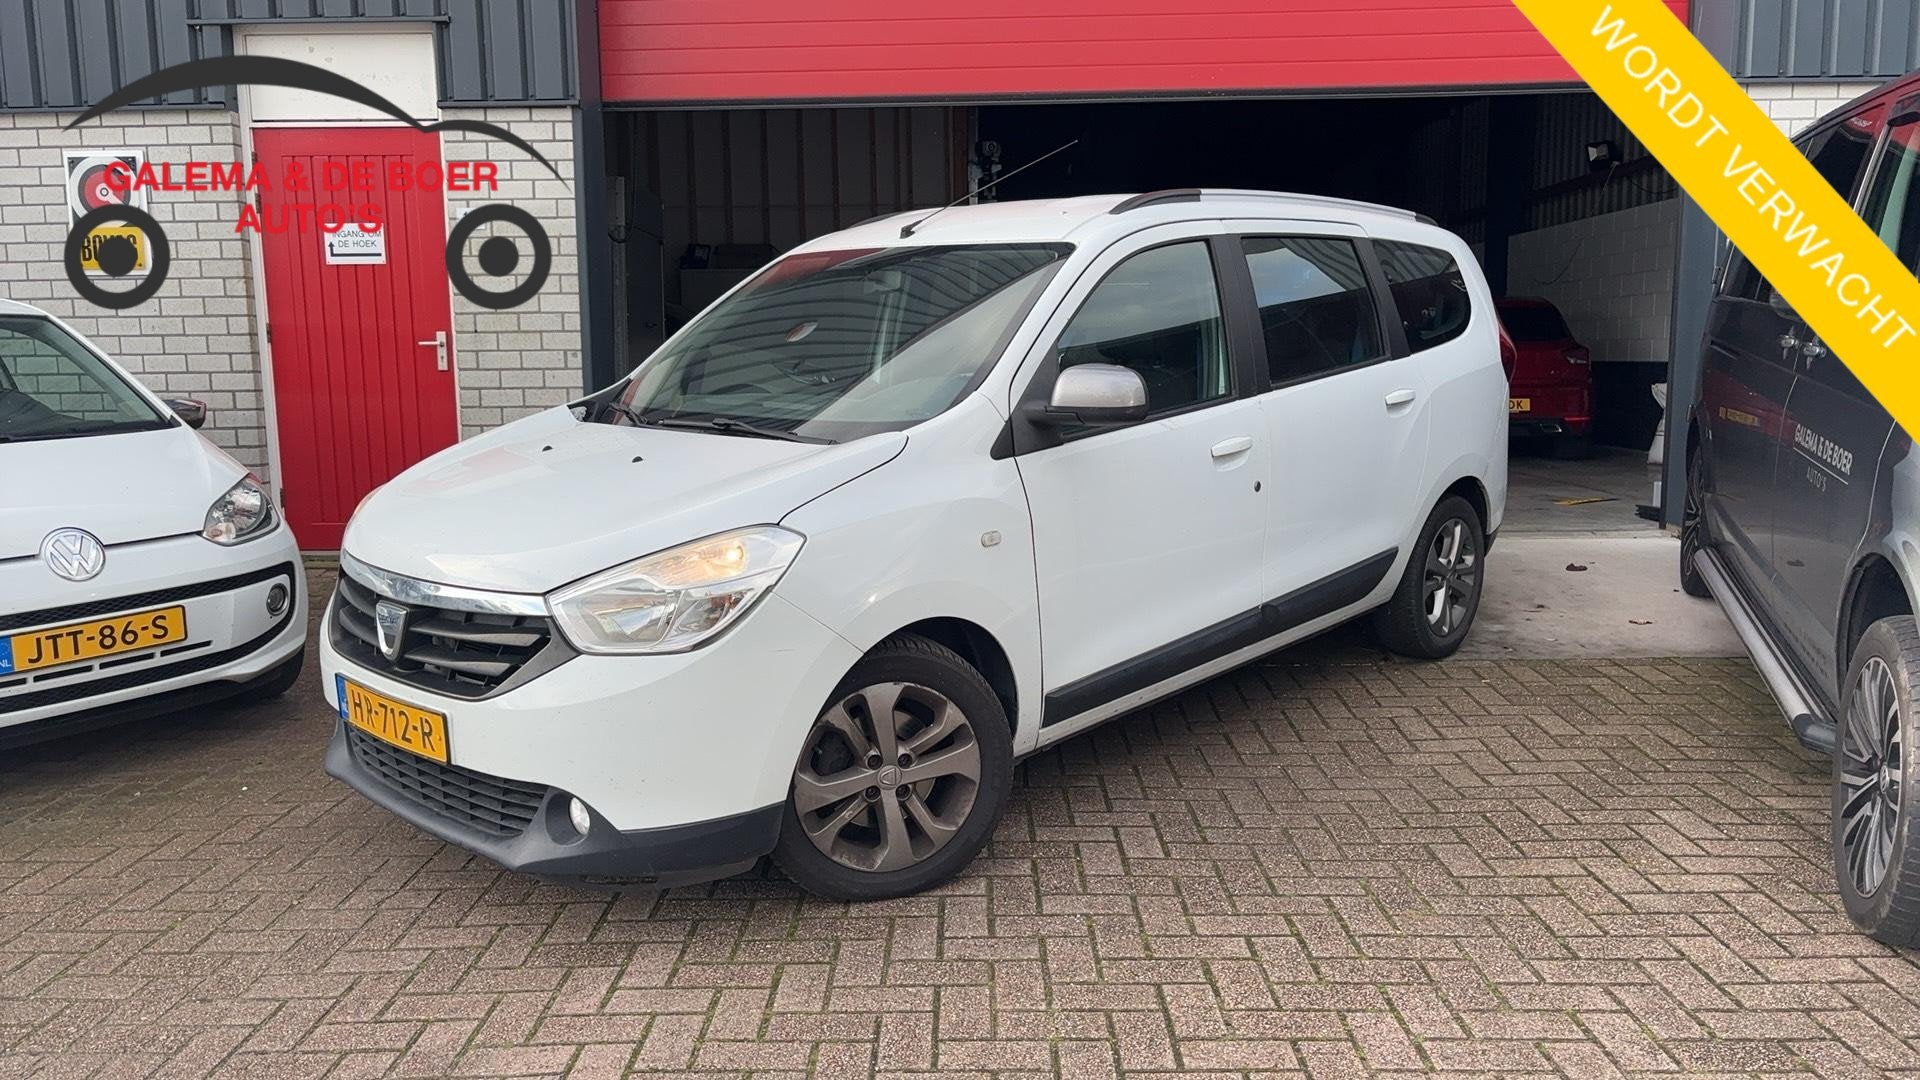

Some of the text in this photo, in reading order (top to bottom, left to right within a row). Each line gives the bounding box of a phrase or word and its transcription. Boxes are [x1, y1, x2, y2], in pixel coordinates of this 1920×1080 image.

[337, 239, 377, 248] DE HOEK
[1794, 423, 1819, 454] GALEMA
[1822, 439, 1834, 463] DE
[1831, 444, 1853, 476] BOER
[27, 614, 169, 664] JTT-86-S
[350, 689, 436, 753] HR-712-R
